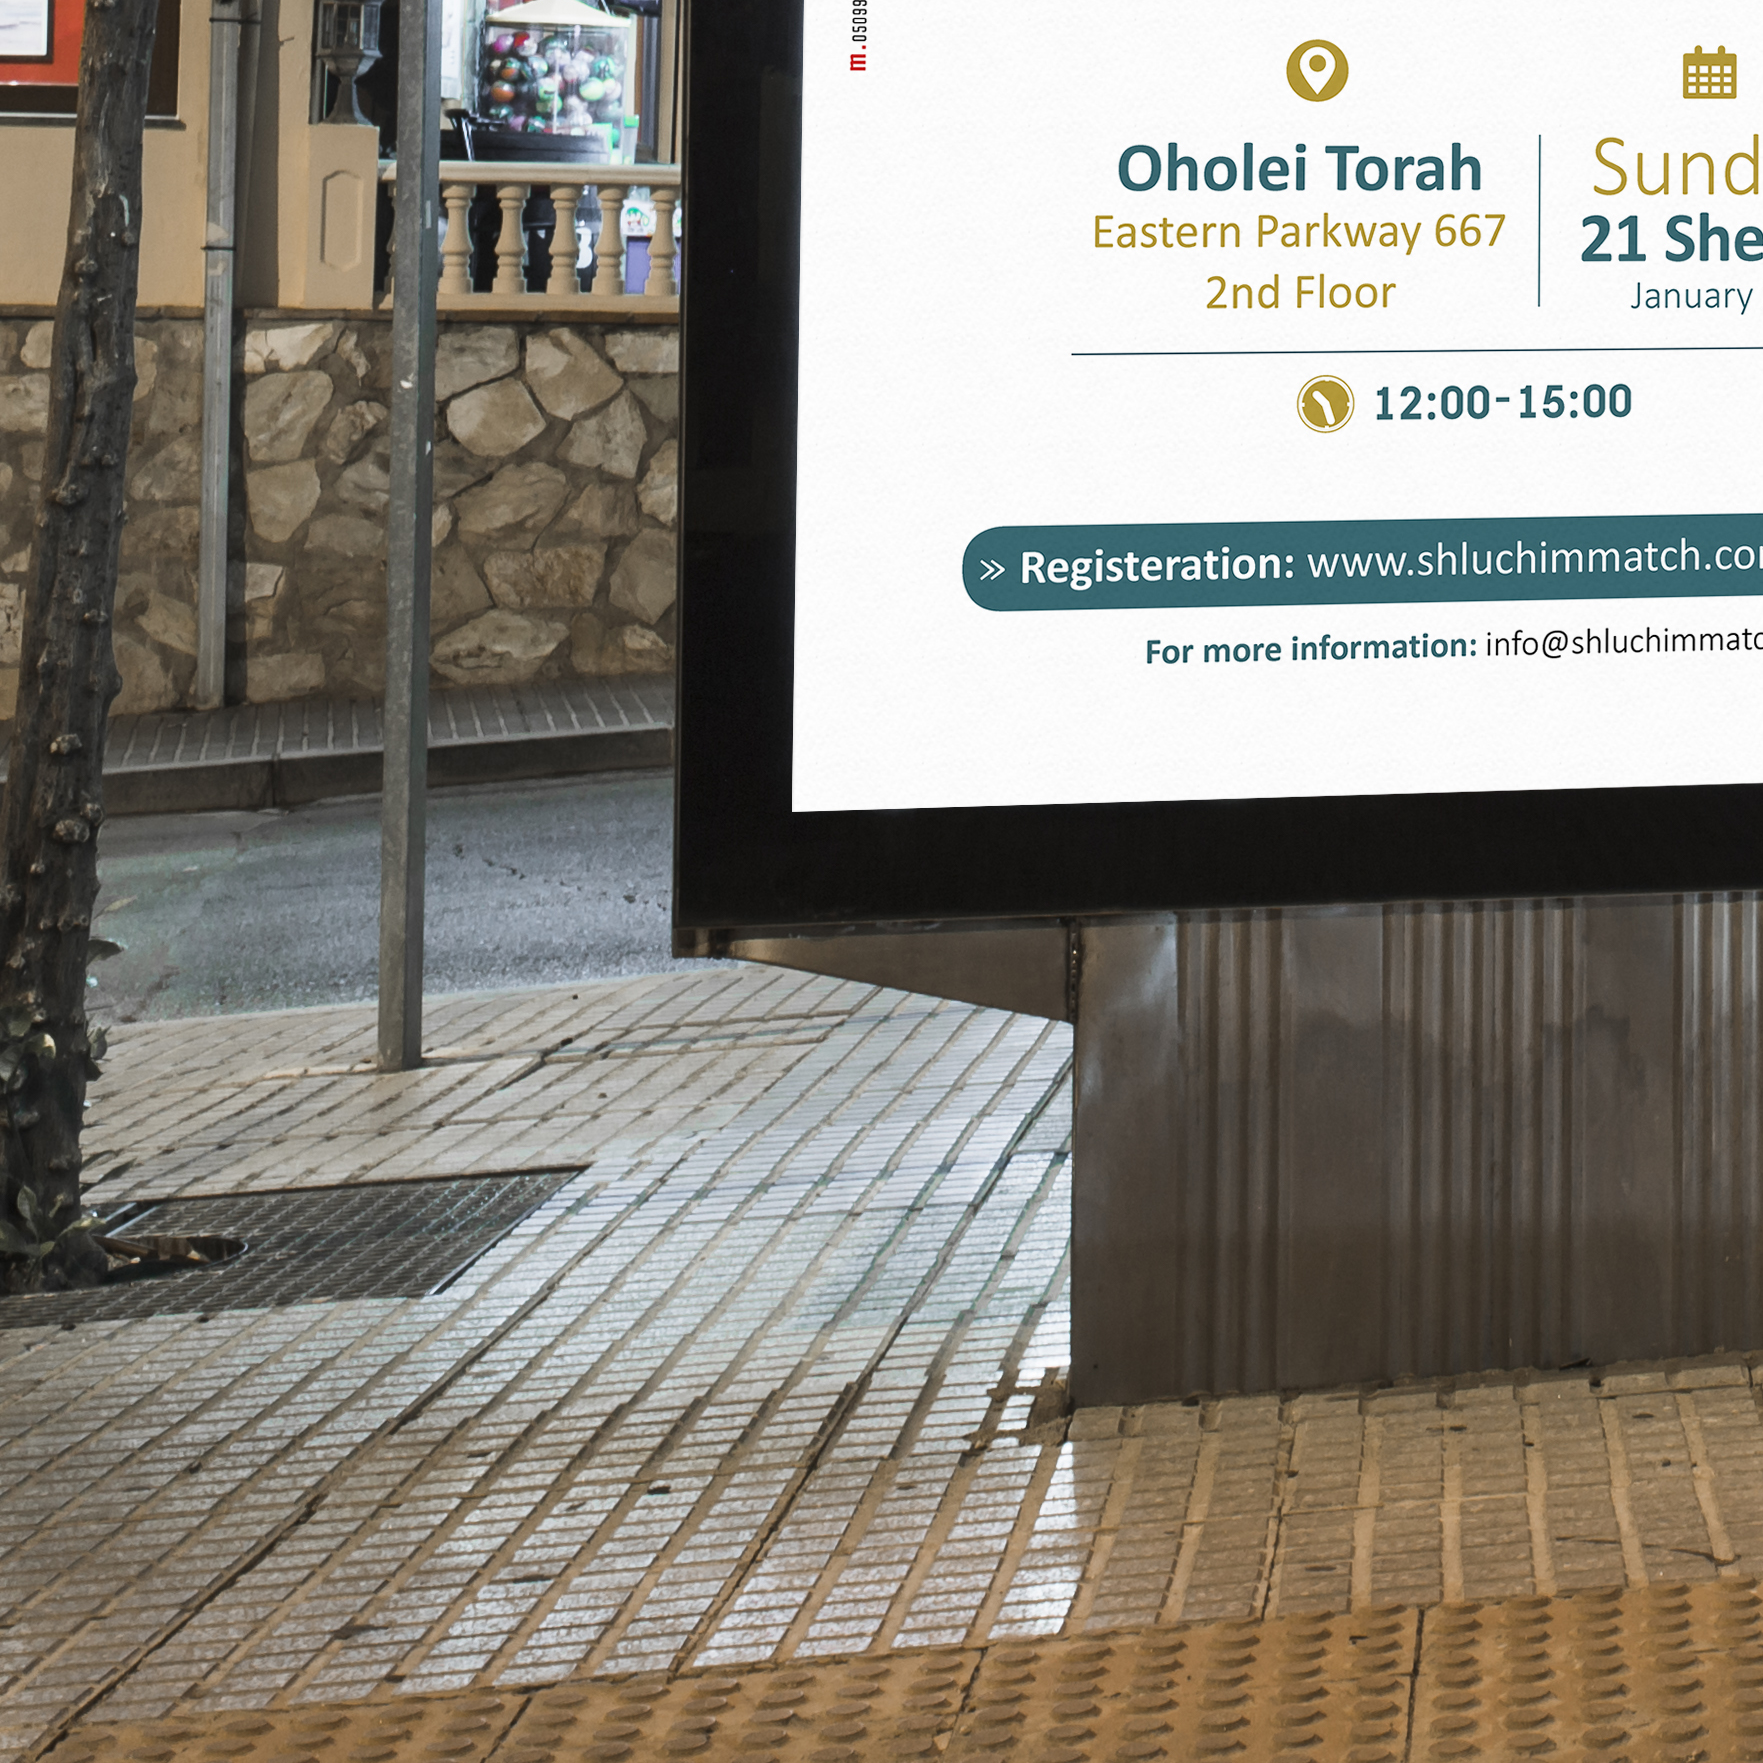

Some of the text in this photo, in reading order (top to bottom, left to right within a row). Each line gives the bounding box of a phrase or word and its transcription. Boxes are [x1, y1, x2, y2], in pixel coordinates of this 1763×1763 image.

[1119, 142, 1480, 191] Oholei Torah
[1095, 213, 1505, 255] Eastern Parkway 667
[1582, 215, 1646, 261] 21
[1207, 274, 1396, 309] 2nd Floor
[1631, 282, 1753, 315] January
[1377, 384, 1631, 420] 12:00-15:00
[1023, 547, 1292, 590] Registeration:
[1147, 640, 1193, 664] For
[1204, 643, 1281, 662] more
[1292, 633, 1476, 660] information:
